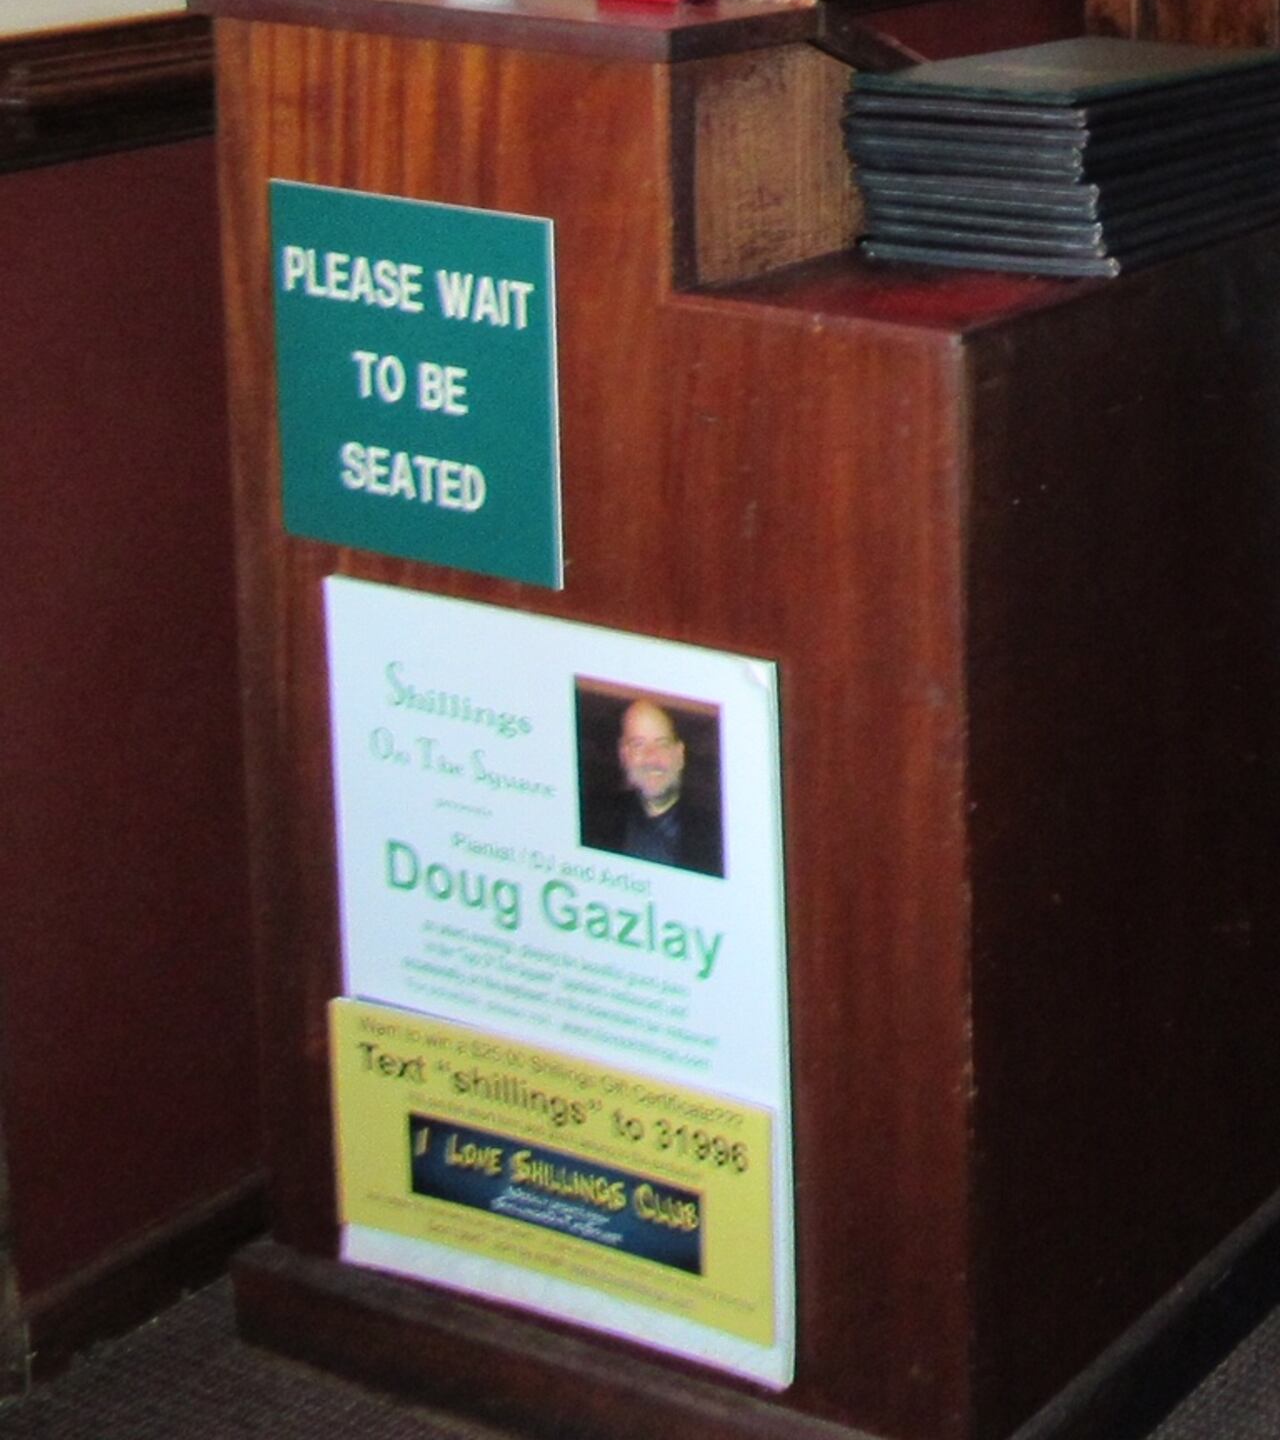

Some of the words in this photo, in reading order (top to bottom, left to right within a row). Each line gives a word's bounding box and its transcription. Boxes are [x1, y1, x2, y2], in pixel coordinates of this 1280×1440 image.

[281, 245, 425, 314] PLEASE
[436, 268, 535, 331] WAIT
[351, 350, 407, 404] TO
[417, 361, 470, 417] BE
[339, 440, 488, 513] SEATED
[385, 660, 534, 739] Shillings
[368, 726, 411, 766] On
[471, 748, 558, 798] Square
[384, 837, 524, 934] Doug
[539, 876, 726, 981] Gazlay
[357, 1040, 427, 1084] Text
[611, 1109, 645, 1142] to
[654, 1117, 750, 1174] 31996
[445, 1132, 503, 1176] LOVE
[510, 1148, 628, 1212] SHILLINGS
[633, 1182, 699, 1233] CLUB
